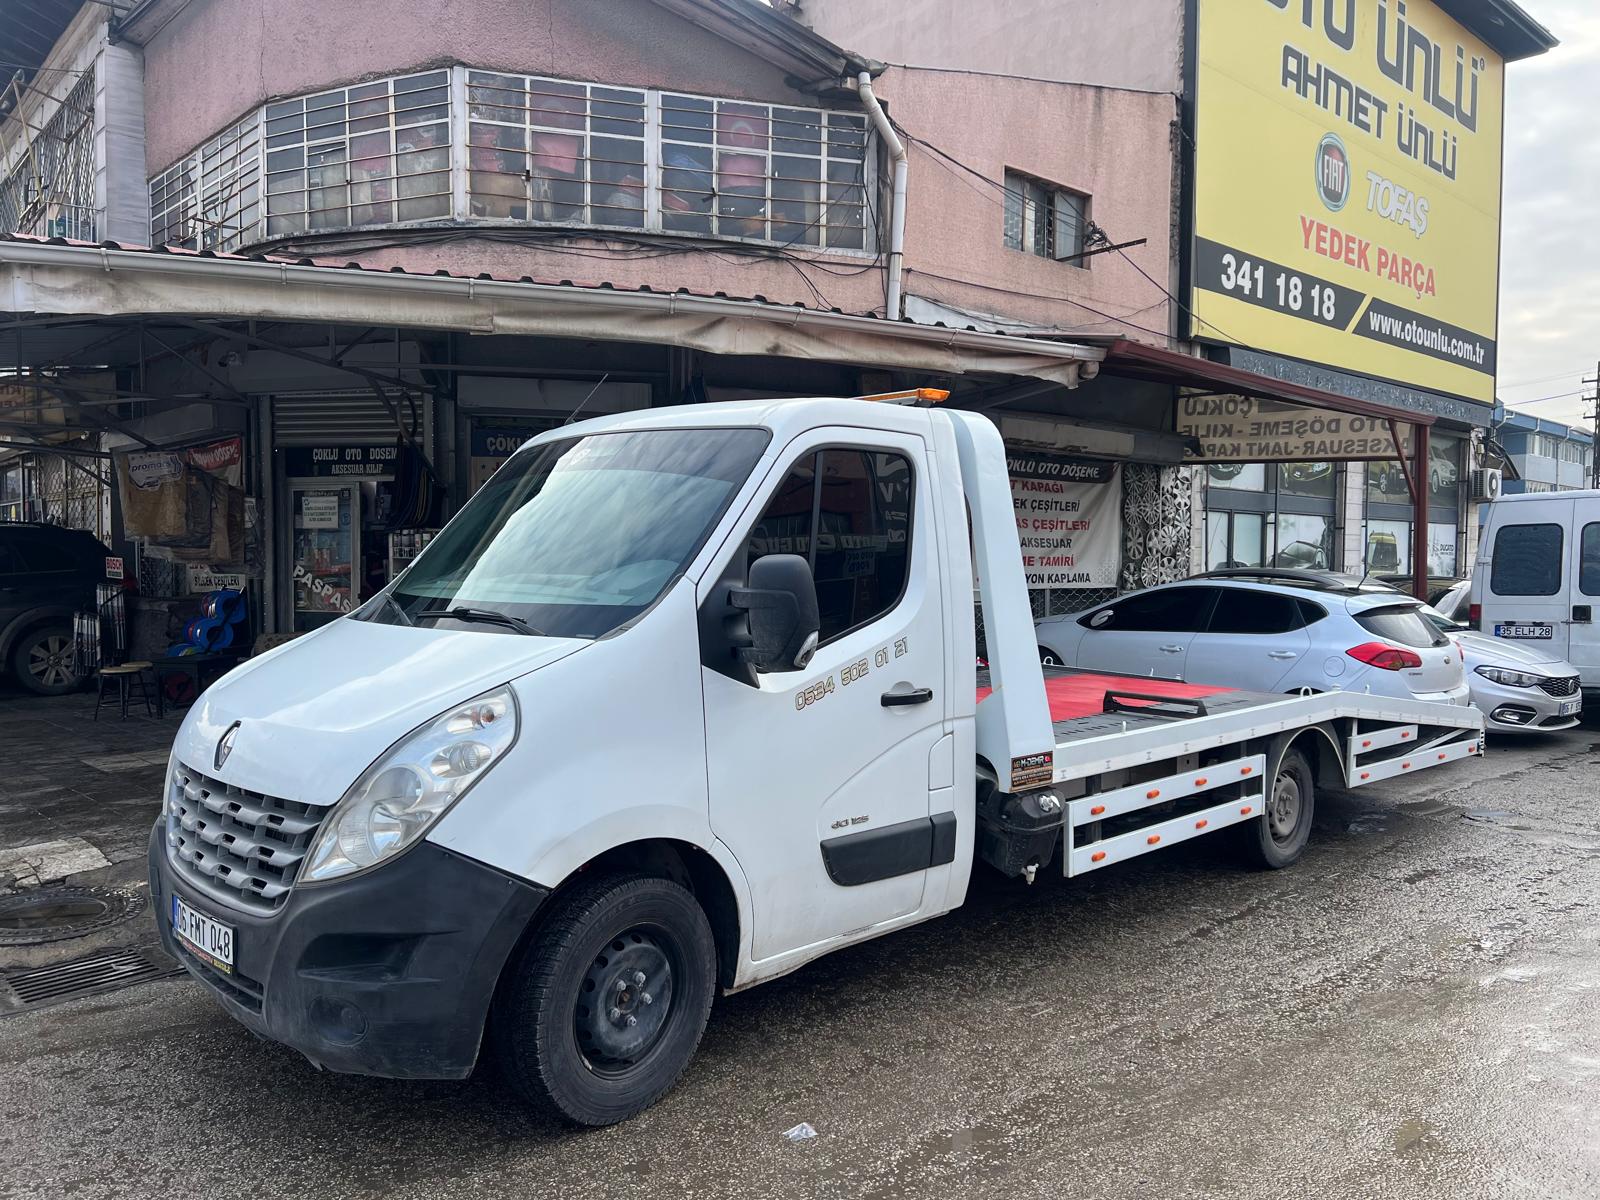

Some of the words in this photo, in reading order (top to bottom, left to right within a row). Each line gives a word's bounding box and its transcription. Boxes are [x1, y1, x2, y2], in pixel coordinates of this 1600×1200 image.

[1376, 0, 1478, 133] ÜNLÜ
[1282, 44, 1388, 139] AHMET
[1398, 102, 1456, 181] ÜNLÜ
[1323, 154, 1344, 193] FIAT
[1366, 170, 1430, 240] TOFAŞ
[1300, 214, 1371, 273] YEDEK
[1377, 247, 1436, 300] PARÇA
[1221, 253, 1265, 300] 341
[1275, 272, 1303, 312] 18
[1310, 284, 1336, 321] 18
[1369, 311, 1485, 365] www.otounlu.com.tr
[345, 448, 362, 461] OTO
[331, 464, 363, 475] AKSESUAR
[1007, 458, 1036, 473] ÖKLÜ
[1038, 462, 1060, 475] OTO
[1062, 463, 1100, 480] DÖŞEME
[1022, 480, 1064, 494] KAPAĞI
[1014, 498, 1028, 509] EK
[1031, 498, 1081, 513] ÇEŞİTLERİ
[1032, 518, 1091, 533] ÇEŞİTLERİ
[1020, 537, 1072, 549] AKSESUAR
[106, 558, 123, 570] BOSCH
[1039, 553, 1074, 567] TAMİRİ
[293, 564, 352, 613] PASPAS
[1047, 572, 1091, 584] KAPLAMA
[1501, 627, 1512, 636] 35
[1514, 627, 1536, 636] ELH
[1539, 627, 1551, 636] 28
[795, 676, 836, 711] 0534
[841, 657, 870, 687] 502
[875, 646, 890, 668] 01
[894, 636, 908, 659] 21
[189, 911, 206, 946] FMT
[210, 924, 231, 960] 048
